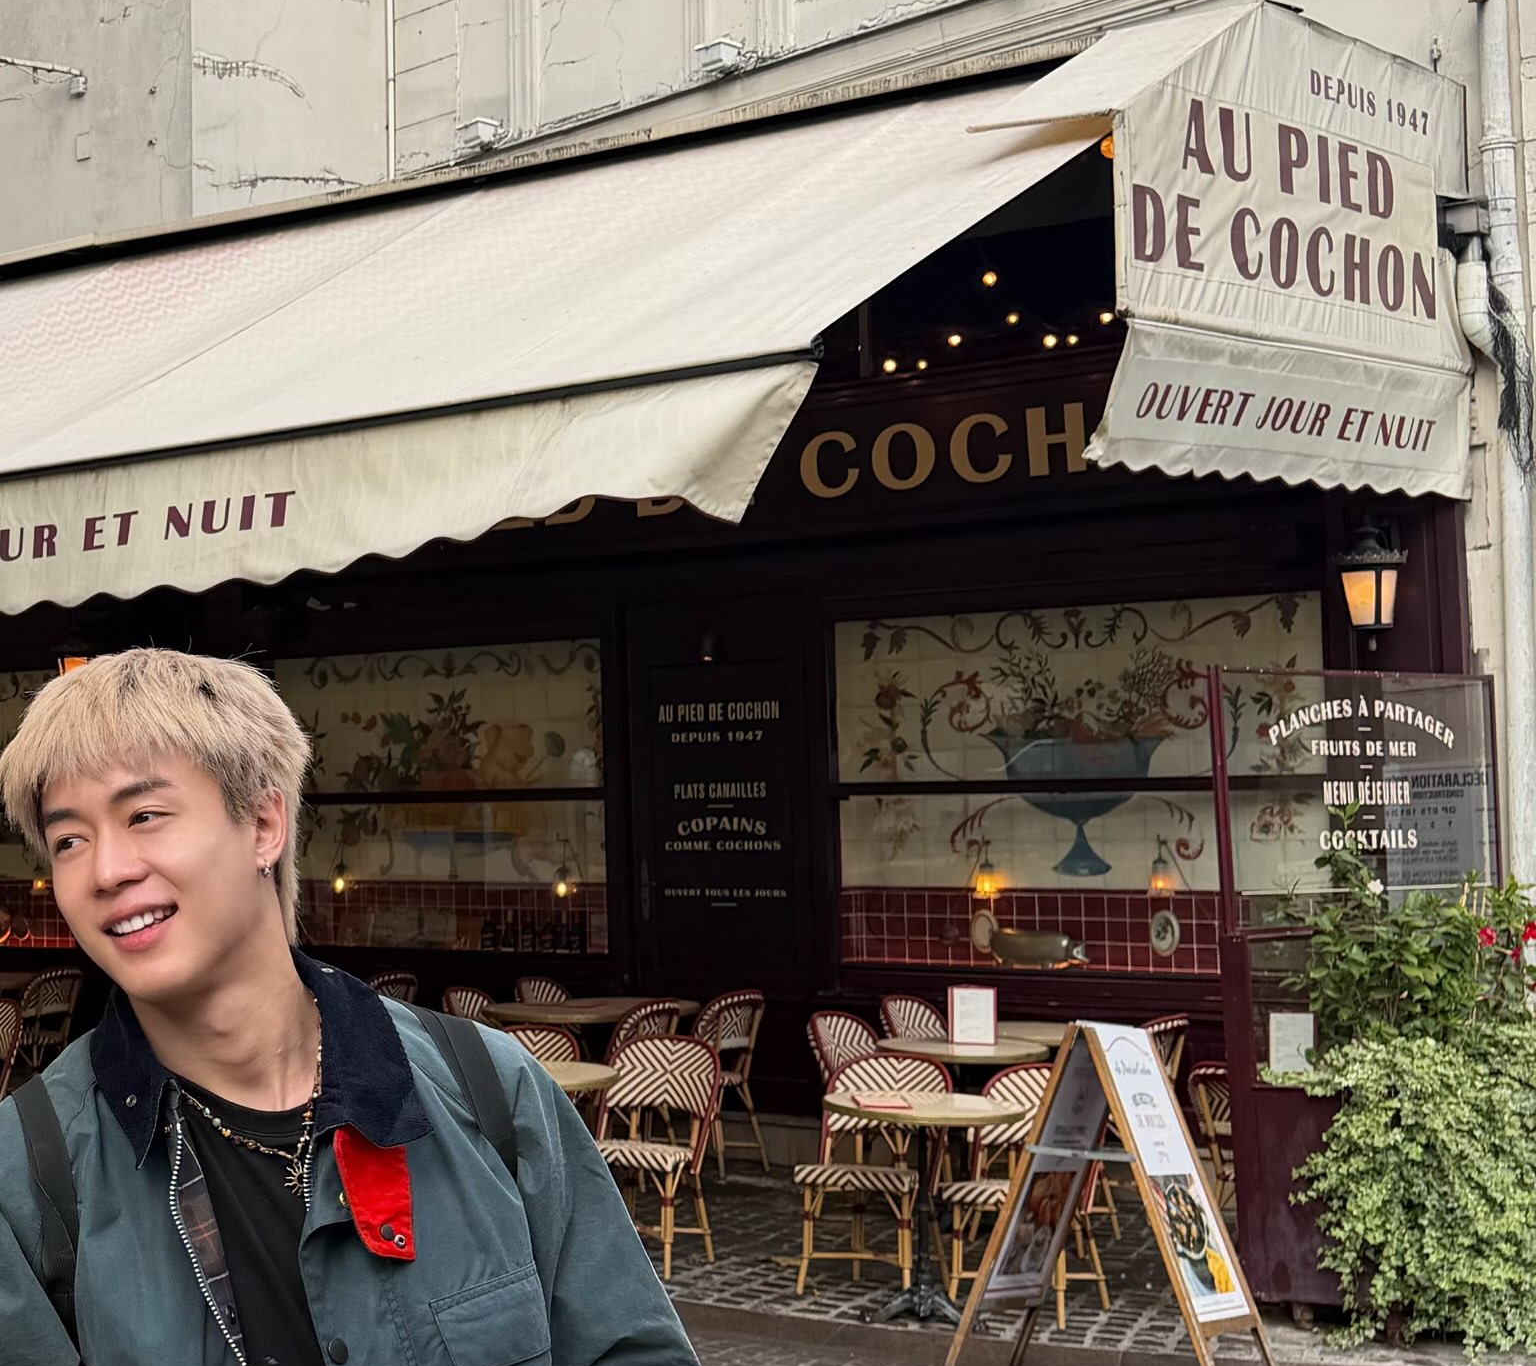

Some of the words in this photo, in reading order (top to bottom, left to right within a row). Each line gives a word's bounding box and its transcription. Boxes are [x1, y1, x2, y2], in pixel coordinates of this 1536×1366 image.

[1309, 67, 1376, 118] DEPUIS
[1386, 97, 1430, 136] 1947
[1182, 97, 1253, 182] AU
[1277, 122, 1394, 220] PIED
[1131, 183, 1205, 273] DE
[1230, 207, 1437, 321] COCHON
[1135, 381, 1256, 428] OUVERT
[1255, 395, 1332, 437] JOUR
[1336, 407, 1375, 445] ET
[1374, 412, 1437, 453] NUIT
[799, 401, 1088, 499] COCH
[82, 510, 140, 552] ET
[164, 490, 297, 541] NUIT
[658, 704, 674, 723] AU
[677, 703, 705, 723] PIED
[708, 702, 724, 722] DE
[727, 700, 780, 721] COCHON
[1268, 698, 1353, 747] PLANCHES
[1358, 694, 1369, 718] À
[1374, 699, 1455, 749] PARTAGER
[671, 731, 721, 743] DEPUIS
[726, 730, 764, 742] 1947
[1311, 739, 1361, 757] FRUITS
[1365, 739, 1384, 757] DE
[1388, 740, 1417, 757] MER
[673, 782, 706, 800] PLATS
[708, 781, 767, 799] CANAILLES
[1322, 781, 1355, 806] MENU
[1358, 775, 1411, 805] DÉJEUNER
[677, 816, 767, 836] COPAINS
[1319, 828, 1418, 851] COCKTAILS
[665, 840, 712, 851] COMME
[716, 839, 782, 851] COCHONS
[664, 888, 701, 897] OUVERT
[733, 888, 751, 898] LES
[754, 888, 787, 898] JOURS
